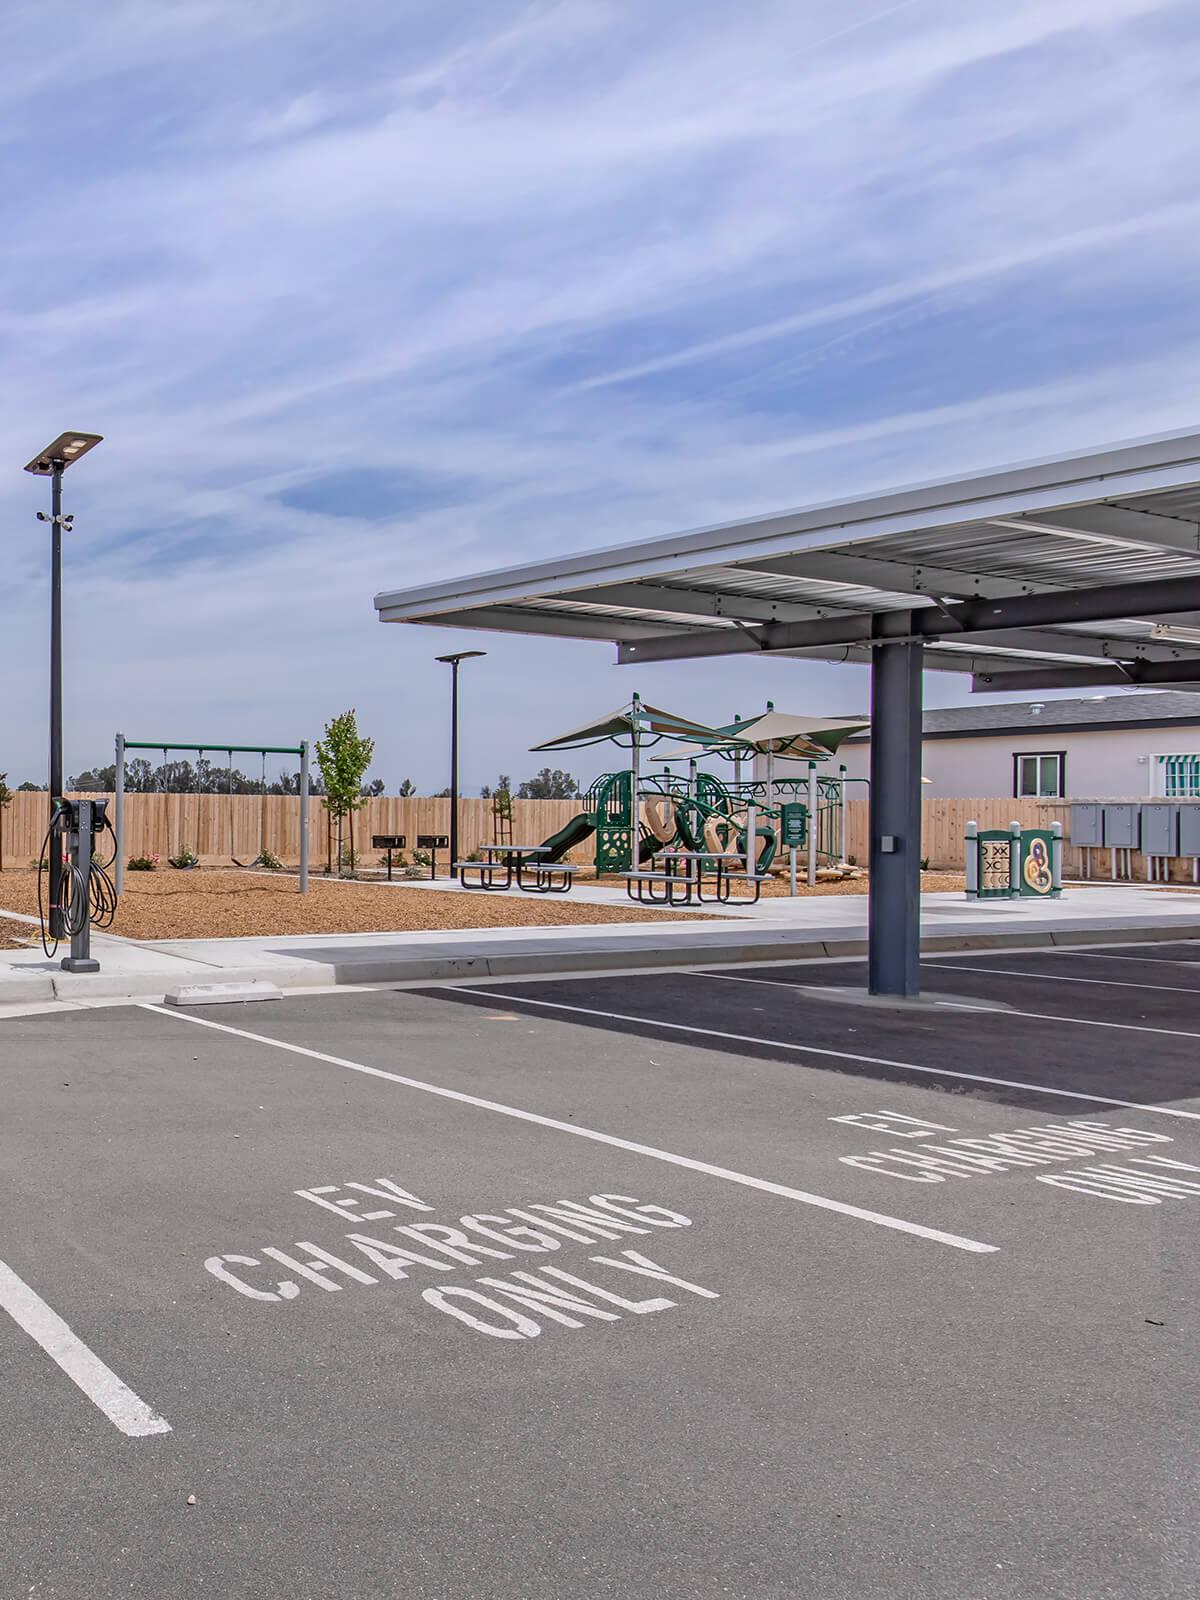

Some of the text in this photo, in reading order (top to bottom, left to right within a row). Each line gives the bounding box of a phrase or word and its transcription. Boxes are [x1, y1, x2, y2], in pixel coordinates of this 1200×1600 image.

[293, 1178, 436, 1222] EV
[203, 1193, 693, 1302] CHARGING
[421, 1249, 720, 1340] ONLY
